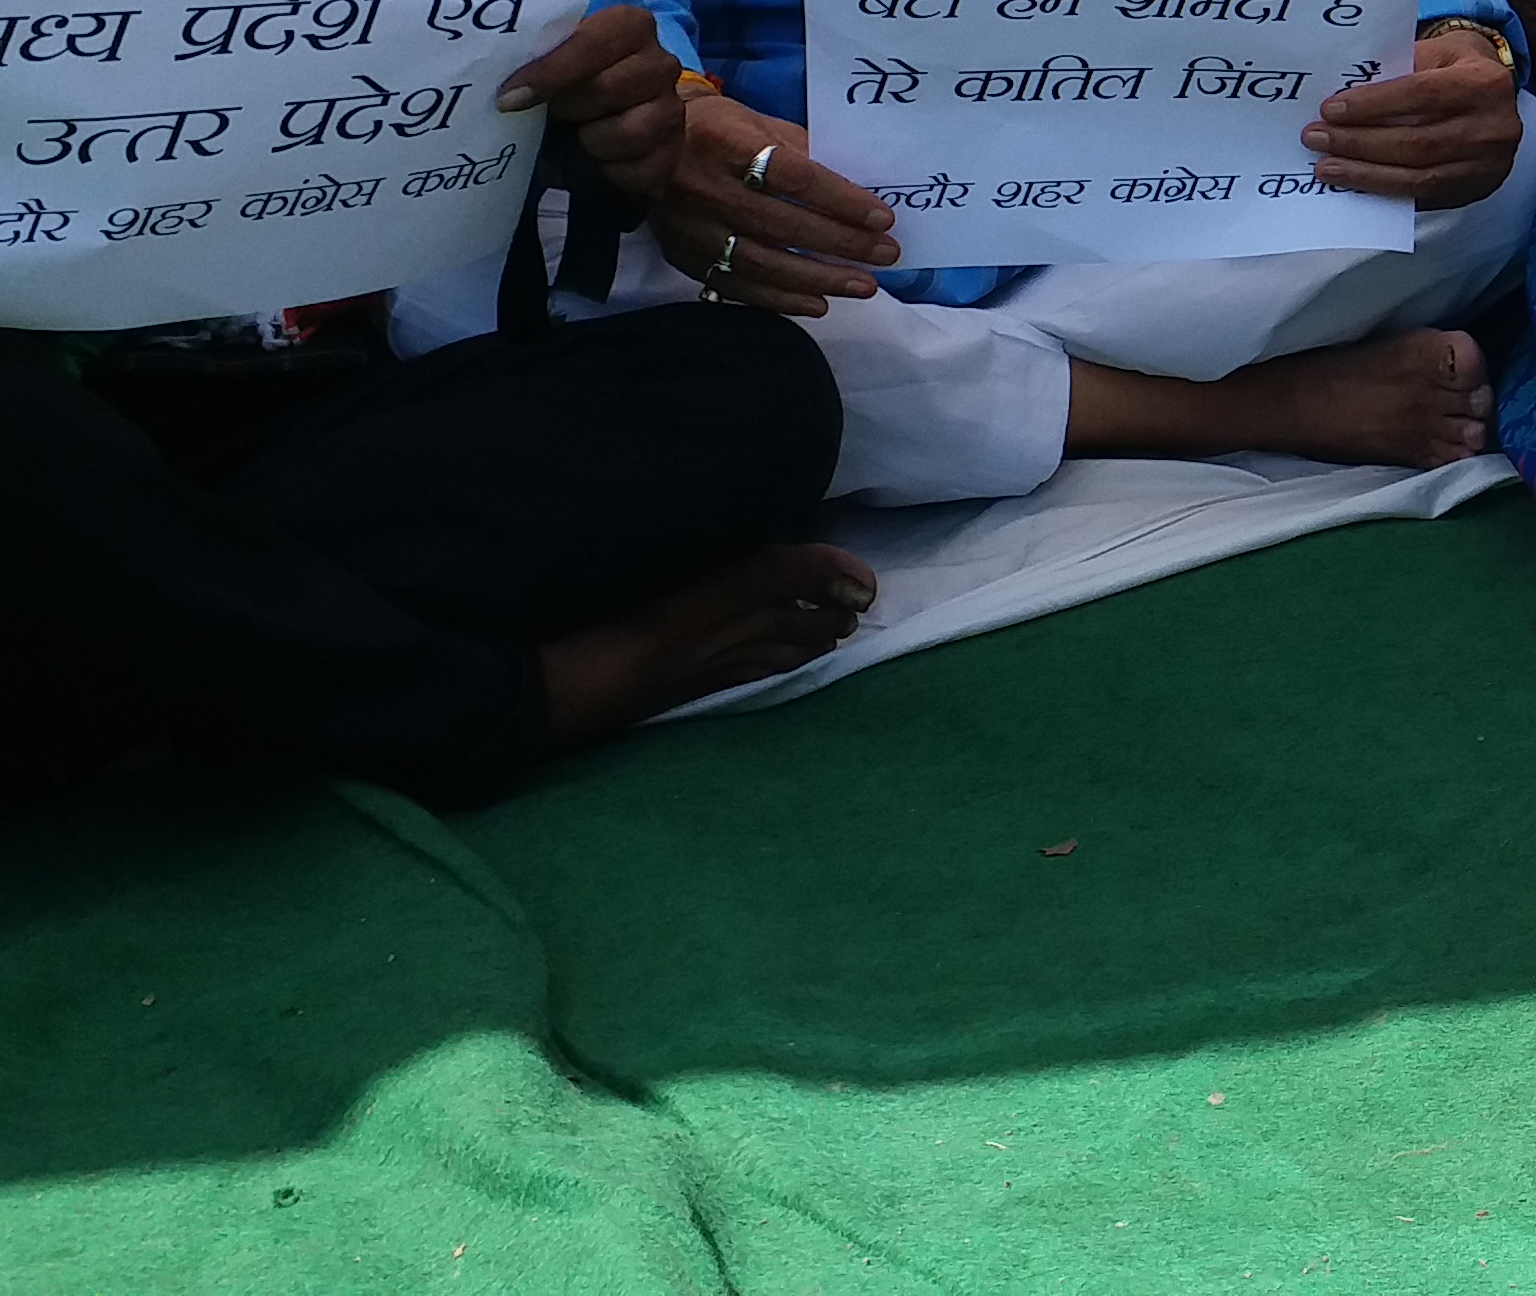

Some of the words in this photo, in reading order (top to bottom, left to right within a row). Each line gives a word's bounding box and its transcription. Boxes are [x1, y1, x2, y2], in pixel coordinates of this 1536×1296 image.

[847, 58, 928, 104] तेरे
[954, 55, 1153, 102] कातिल
[1173, 56, 1312, 102] जिंदा
[16, 107, 243, 165] उत्तर
[271, 75, 472, 153] प्रदेश
[99, 199, 221, 241] शहर
[240, 174, 387, 221] कांग्रेस
[400, 142, 517, 200] कमेटी
[864, 172, 976, 212] न्दौर
[991, 180, 1092, 208] शहर
[1110, 166, 1241, 203] कांग्रेस
